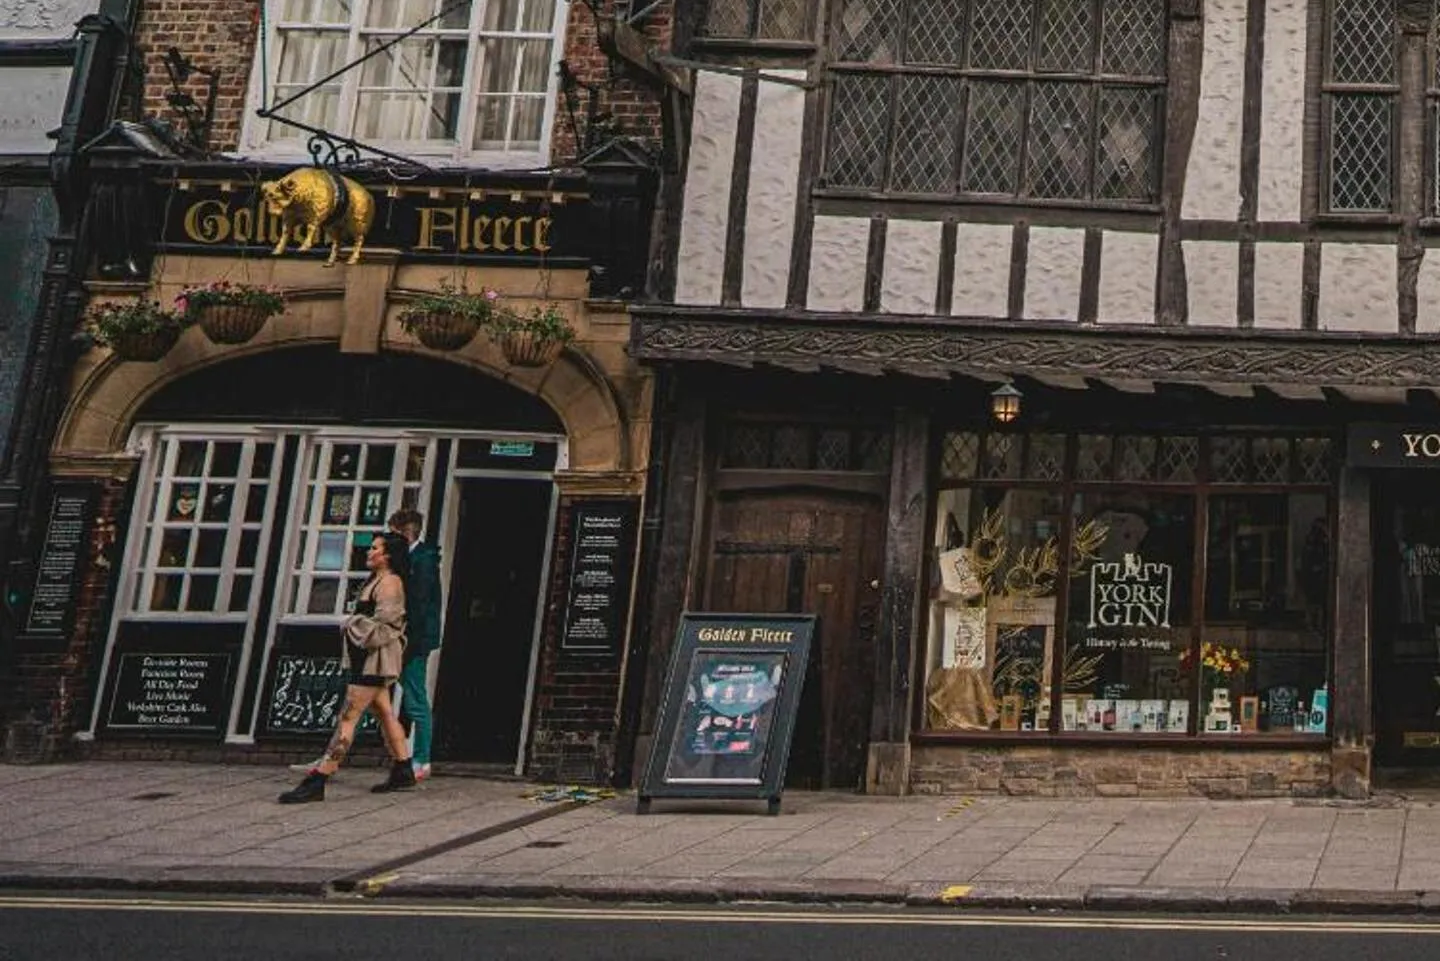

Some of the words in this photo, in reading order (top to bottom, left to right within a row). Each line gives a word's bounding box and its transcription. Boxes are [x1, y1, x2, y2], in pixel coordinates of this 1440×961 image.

[414, 206, 553, 252] Fleece
[1098, 583, 1164, 604] YORK
[1098, 602, 1161, 626] GIN
[698, 627, 747, 642] Golden
